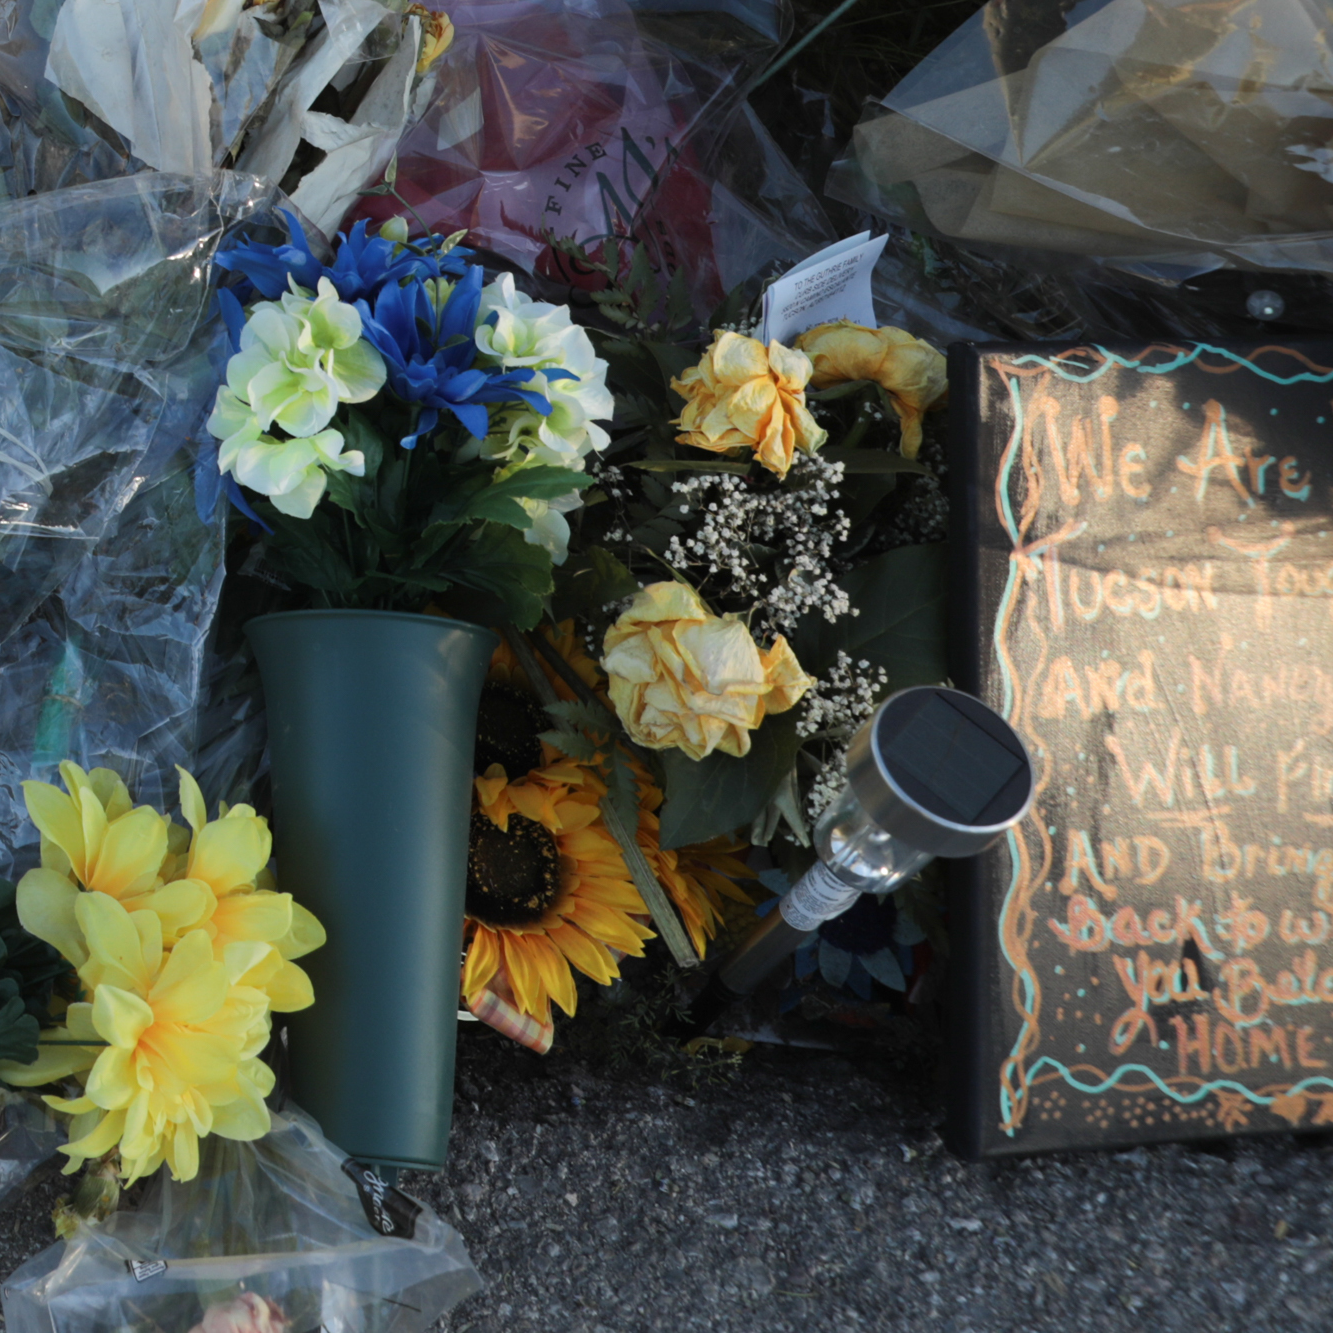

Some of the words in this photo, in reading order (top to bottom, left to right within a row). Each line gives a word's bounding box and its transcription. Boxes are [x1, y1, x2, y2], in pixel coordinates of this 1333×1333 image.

[545, 141, 607, 216] FINE
[1030, 395, 1152, 506] We
[1176, 398, 1312, 509] Are
[1021, 519, 1219, 633] Tucson
[1058, 827, 1172, 901] AND
[1170, 1012, 1326, 1075] HOME
